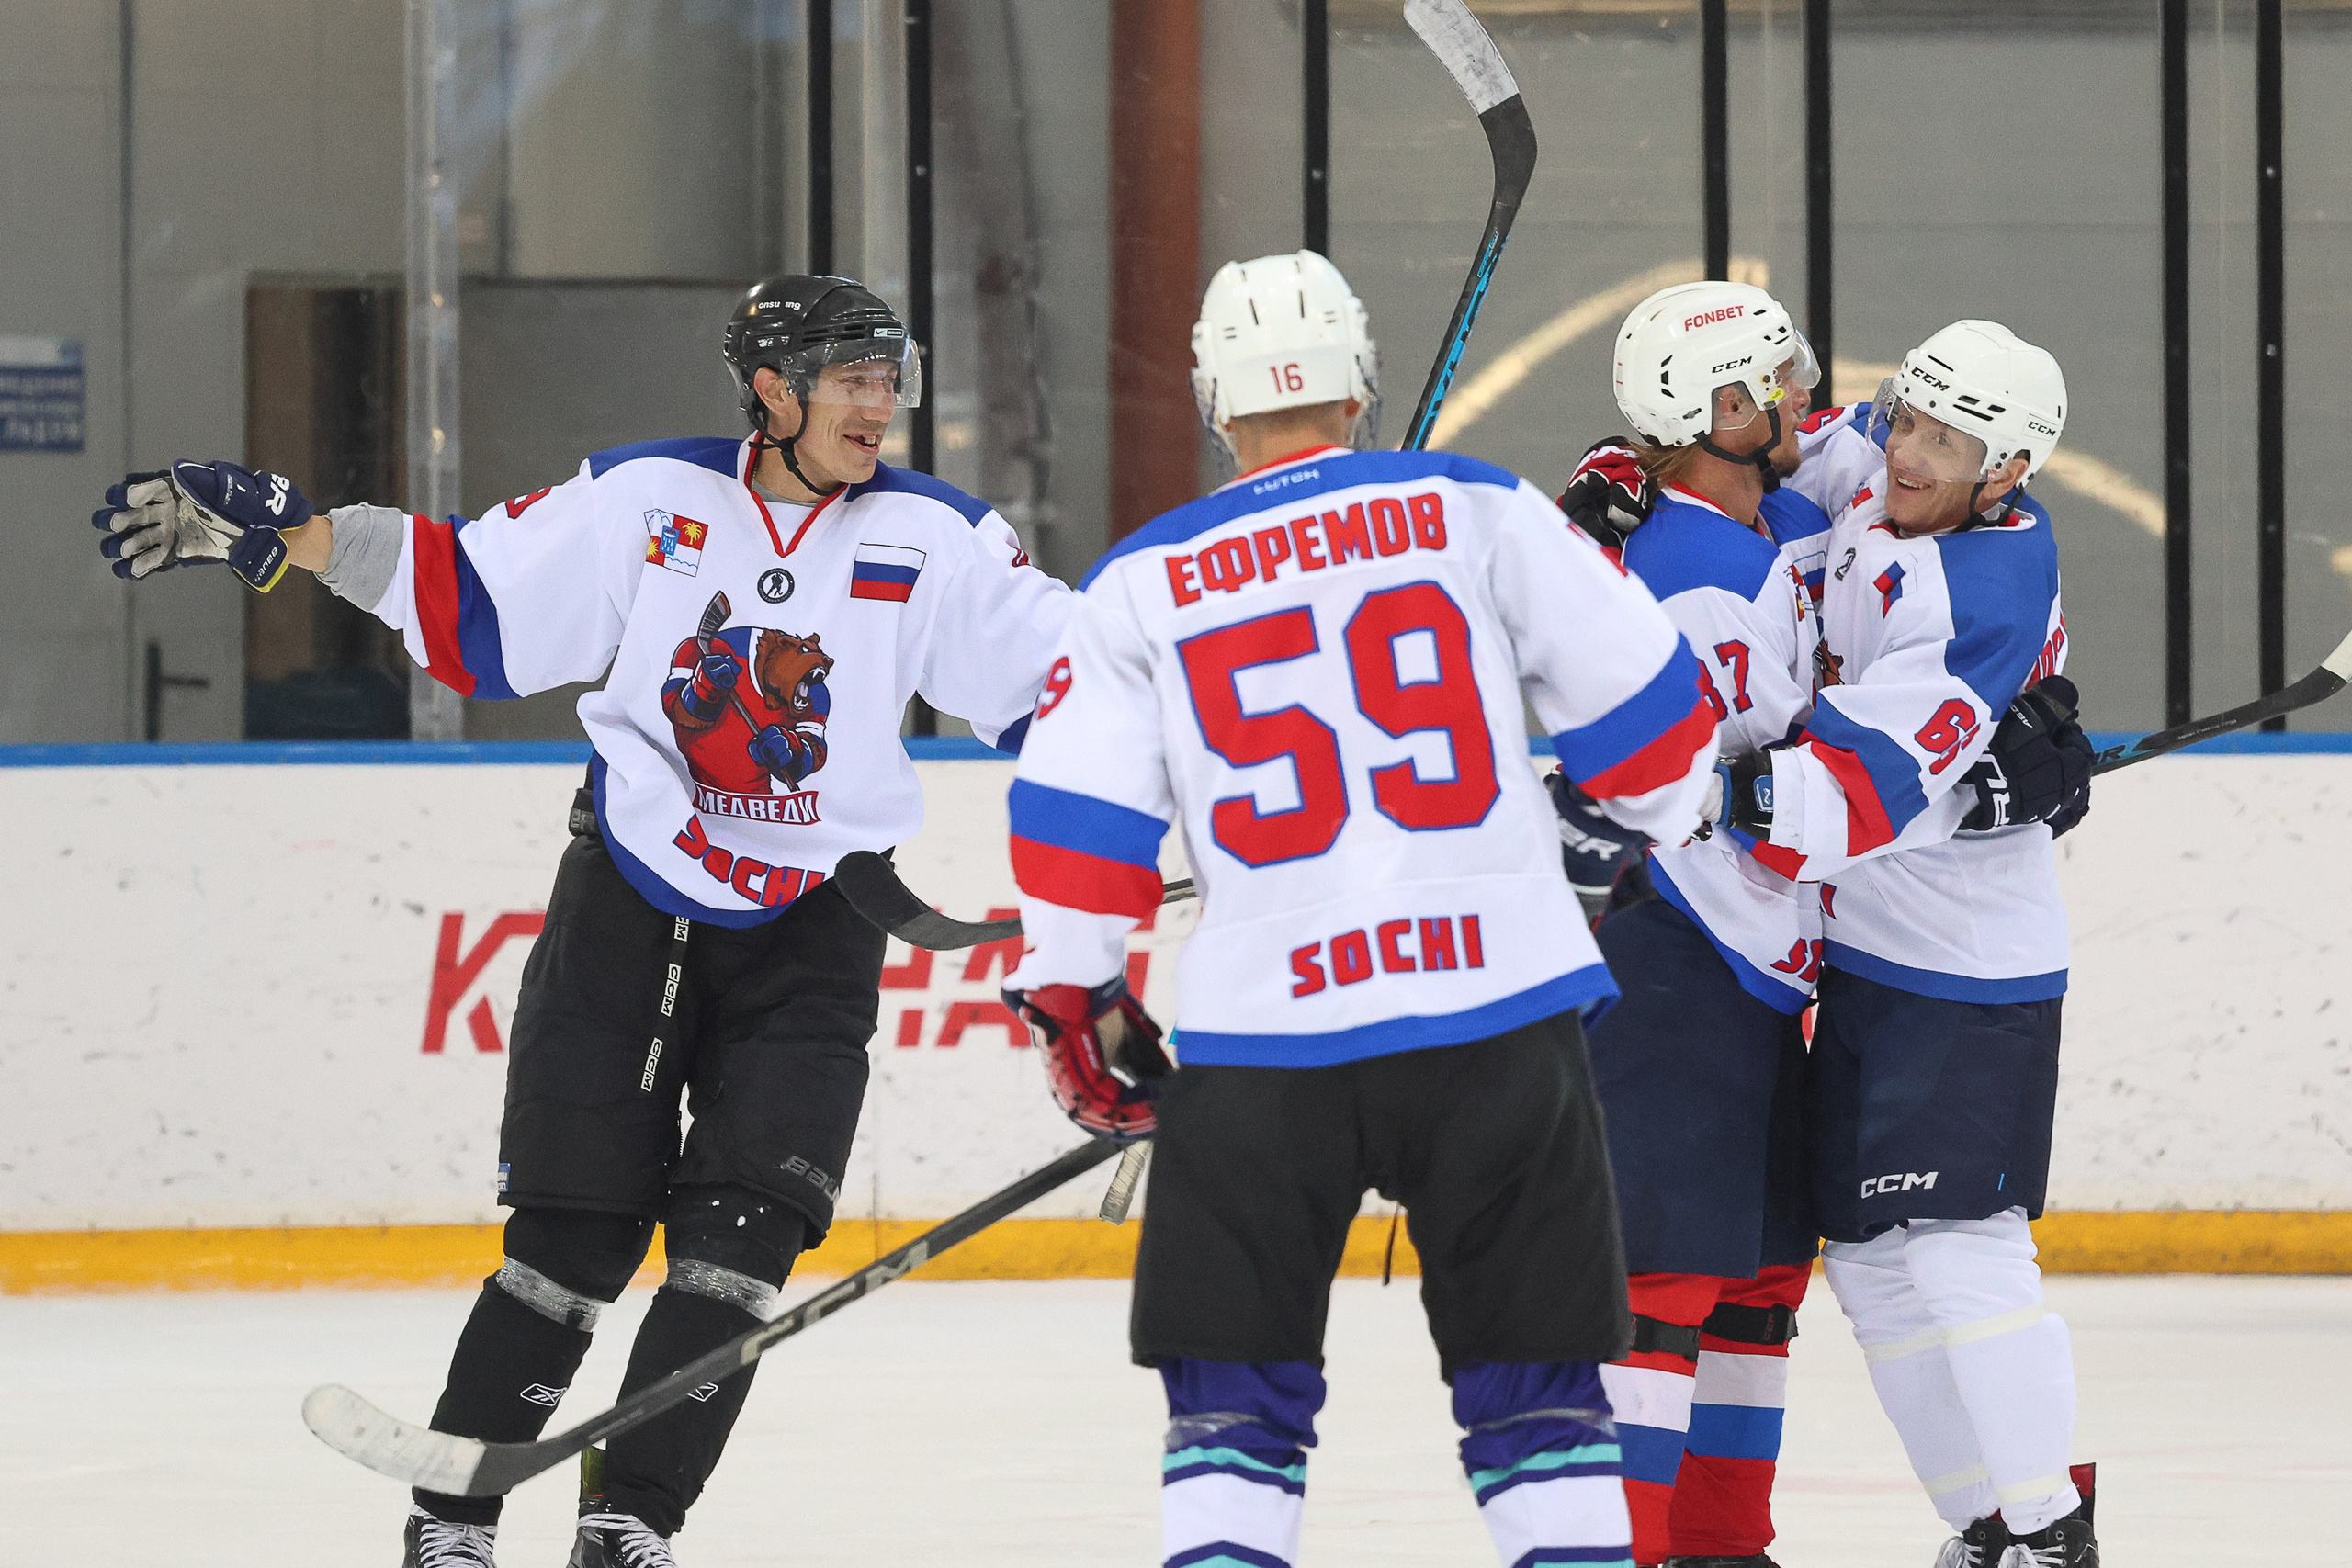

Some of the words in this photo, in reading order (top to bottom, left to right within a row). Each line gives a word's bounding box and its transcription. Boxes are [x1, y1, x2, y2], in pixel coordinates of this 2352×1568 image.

[1684, 305, 1744, 332] FONBET
[1269, 363, 1304, 394] 16
[1712, 355, 1752, 374] CCM
[1911, 367, 1951, 392] CCM
[2028, 421, 2057, 437] CCM
[1164, 491, 1448, 608] ЕФРЕМОВ
[1175, 581, 1501, 869] 59
[696, 785, 817, 824] МЕДВЕДИ
[1290, 914, 1485, 998] SOCHI
[662, 964, 681, 1017] CCM
[641, 1037, 663, 1092] CCM
[1860, 1171, 1939, 1199] CCM
